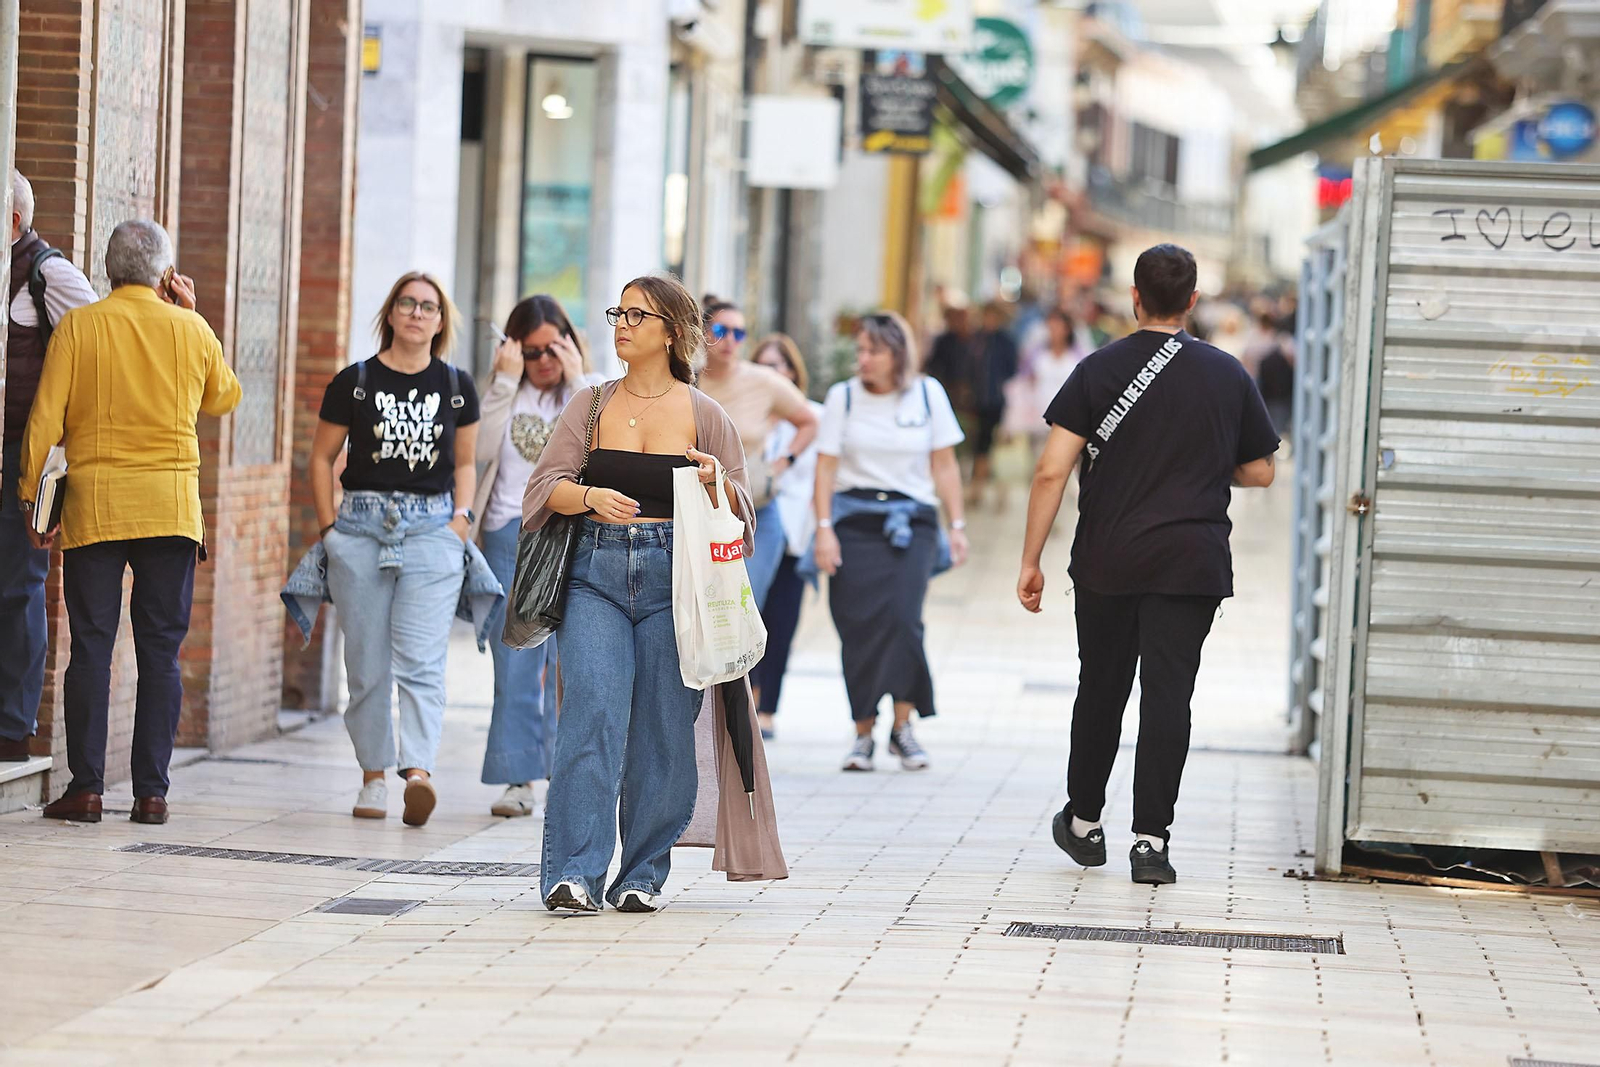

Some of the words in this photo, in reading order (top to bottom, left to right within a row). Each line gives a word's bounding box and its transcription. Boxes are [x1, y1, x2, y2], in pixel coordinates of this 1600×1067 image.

[1146, 337, 1183, 374] GALLOS
[1132, 367, 1156, 392] LOS
[1123, 382, 1143, 404] DE
[1095, 396, 1134, 442] BATALLA
[384, 421, 434, 442] LOVE
[381, 441, 435, 462] BACK
